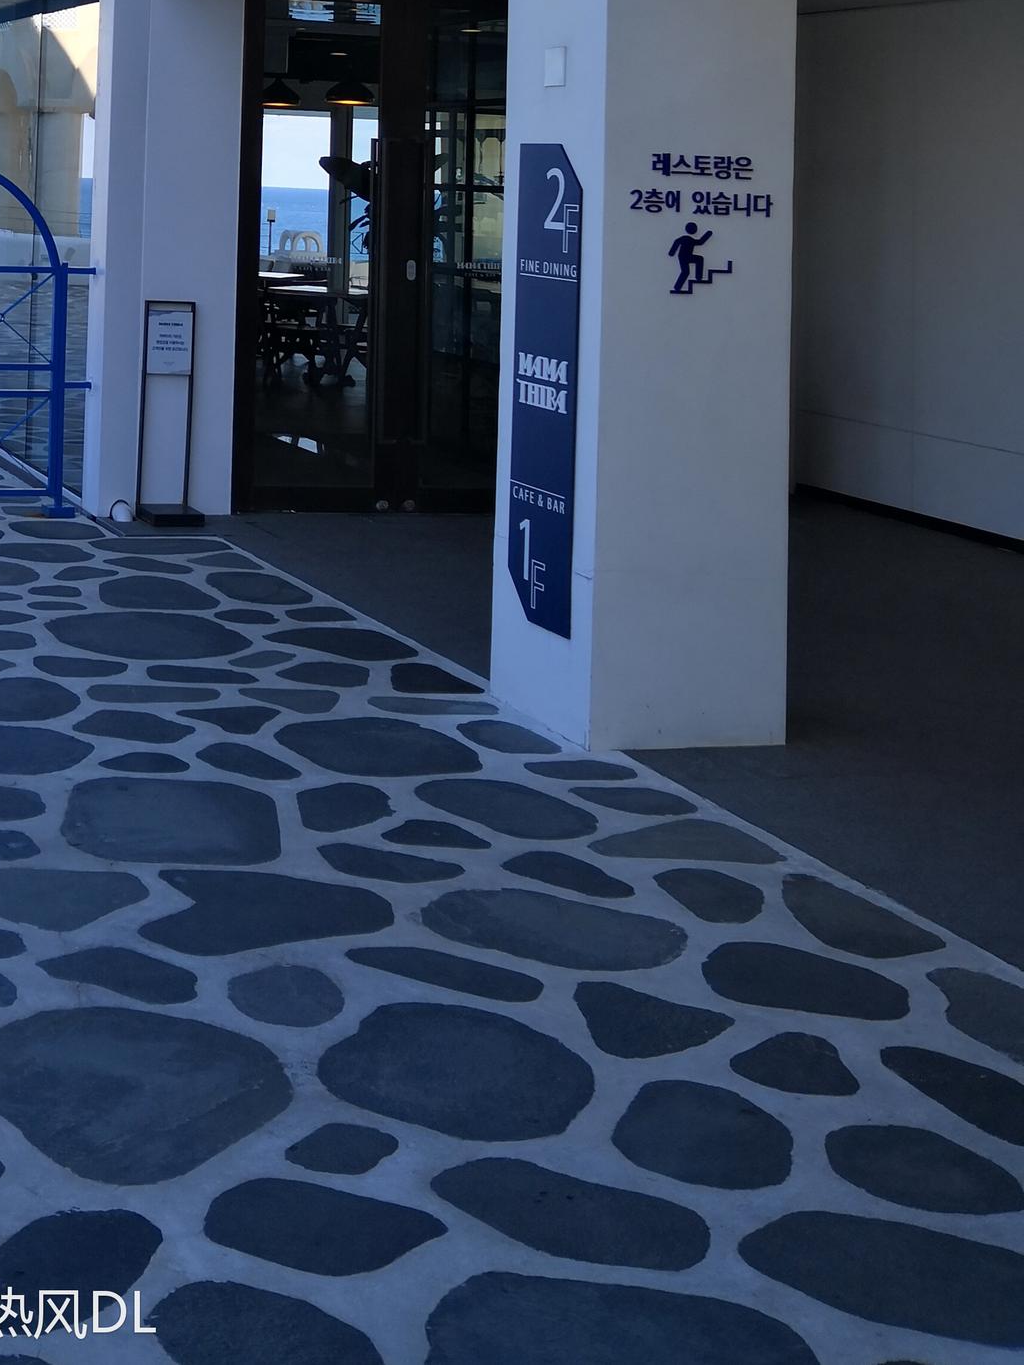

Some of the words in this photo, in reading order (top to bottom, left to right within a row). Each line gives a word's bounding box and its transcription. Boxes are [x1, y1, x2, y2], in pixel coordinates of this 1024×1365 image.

[651, 153, 754, 180] 레스토랑은
[692, 191, 774, 218] 있습니다
[519, 258, 540, 273] FINE
[543, 261, 577, 278] DINING
[518, 352, 569, 385] MAMA
[512, 485, 535, 505] CAFE
[537, 494, 544, 507] &
[547, 496, 566, 515] BAR
